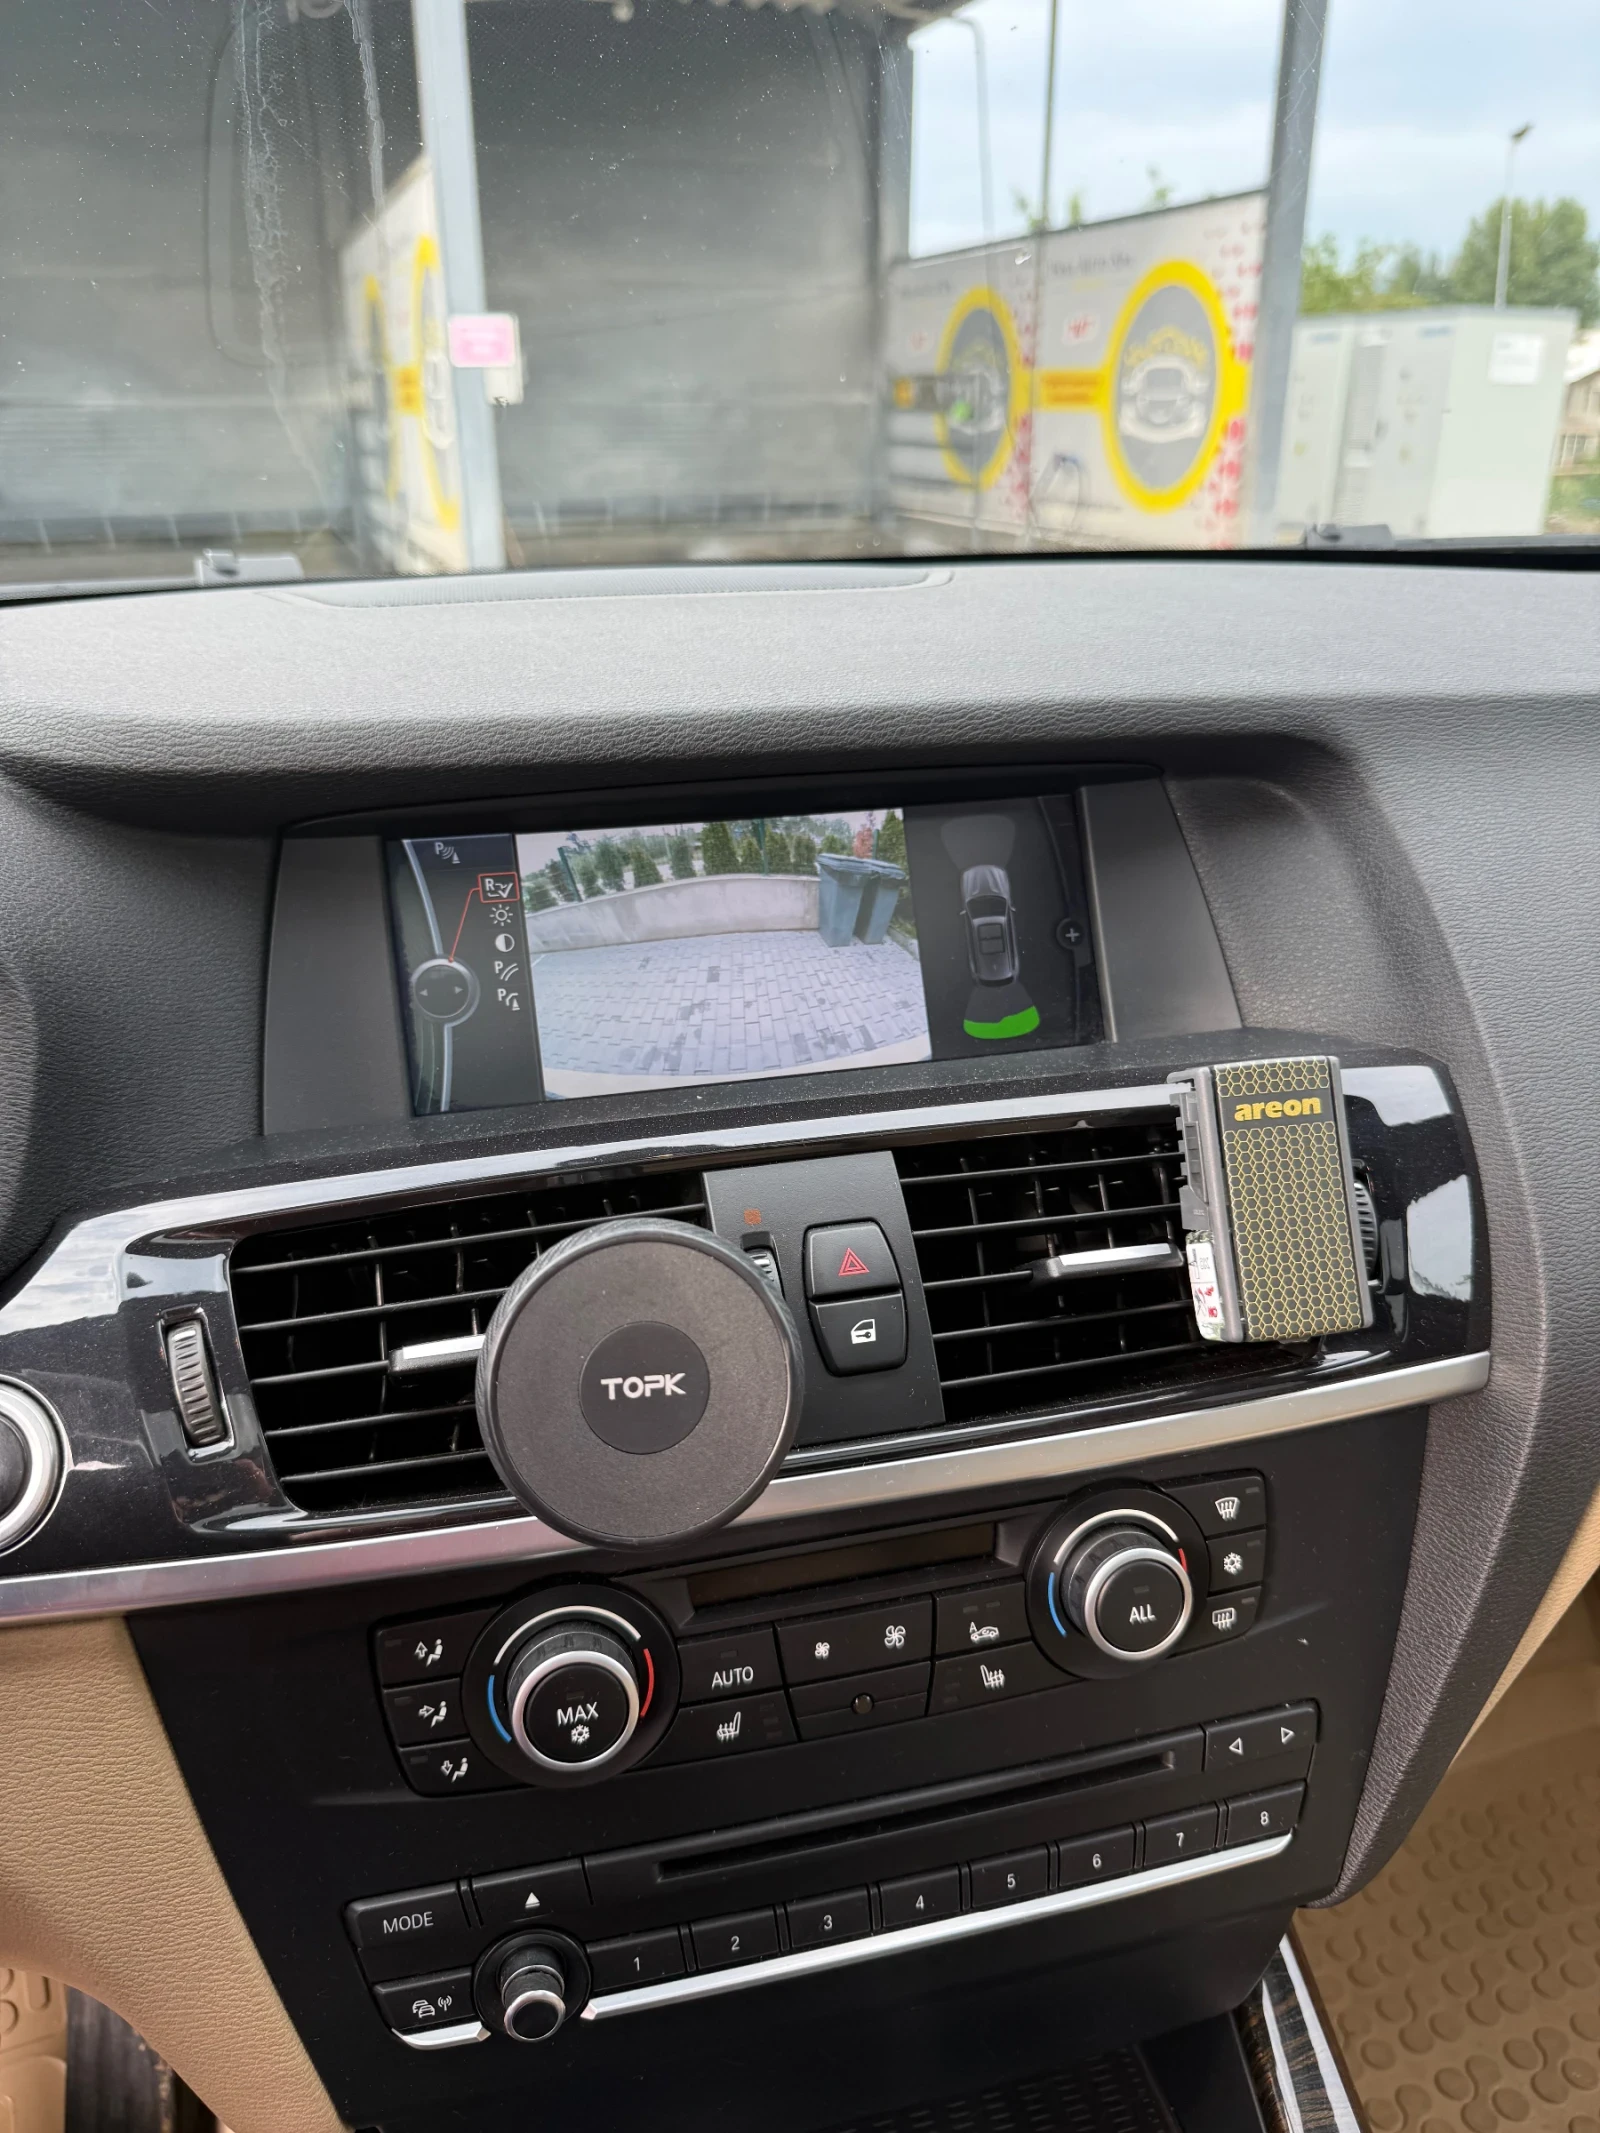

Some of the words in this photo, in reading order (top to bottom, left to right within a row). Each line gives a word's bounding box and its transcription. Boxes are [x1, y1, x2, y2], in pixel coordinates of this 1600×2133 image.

[484, 878, 496, 892] R
[494, 961, 503, 974] P
[497, 989, 507, 1002] P
[1234, 1096, 1323, 1122] areon
[600, 1372, 687, 1401] TOPK
[1129, 1603, 1156, 1624] ALL
[711, 1665, 754, 1689] AUTO
[556, 1701, 599, 1726] MAX
[1259, 1811, 1269, 1826] 8
[1175, 1832, 1185, 1848] 7
[1092, 1853, 1101, 1869] 6
[1006, 1873, 1016, 1889] 5
[915, 1894, 925, 1911] 4
[382, 1910, 435, 1935] MODE
[823, 1915, 833, 1931] 3
[730, 1935, 740, 1952] 2
[633, 1957, 641, 1971] 1
